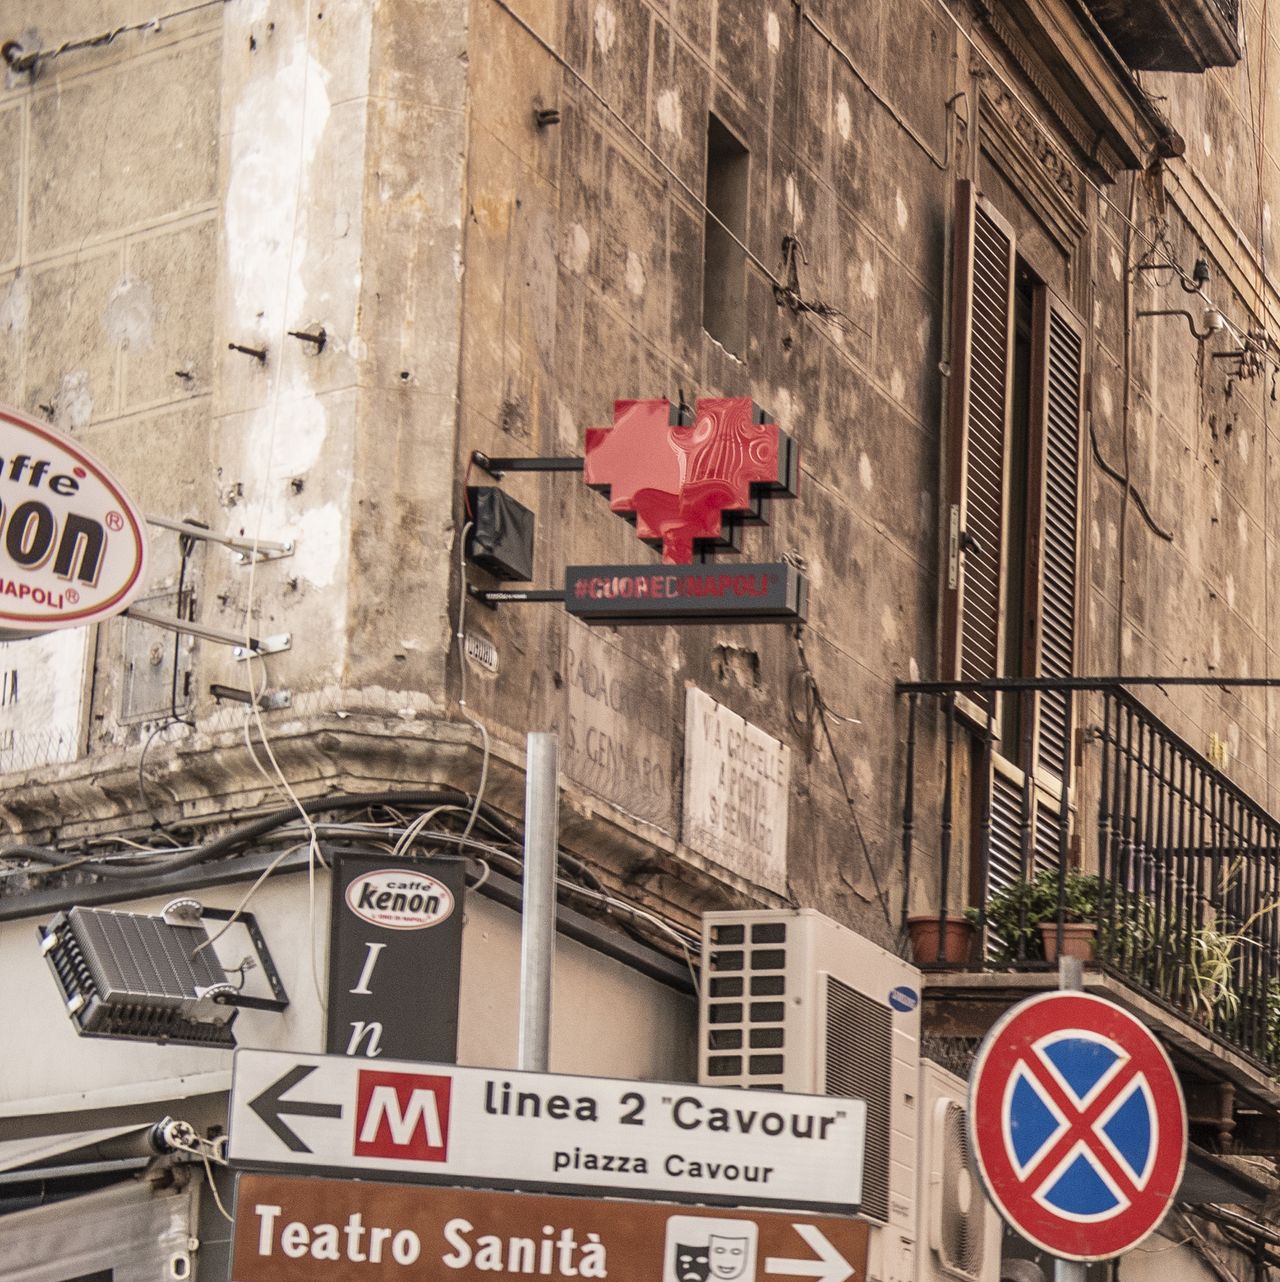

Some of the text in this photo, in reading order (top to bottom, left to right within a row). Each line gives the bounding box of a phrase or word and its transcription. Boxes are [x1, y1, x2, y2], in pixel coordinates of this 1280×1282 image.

[358, 882, 441, 915] kenon
[358, 1086, 445, 1148] M
[484, 1080, 598, 1123] linea
[618, 1091, 646, 1127] 2
[553, 1146, 775, 1185] piazza Cavour
[255, 1203, 609, 1279] Teatro Sanità
